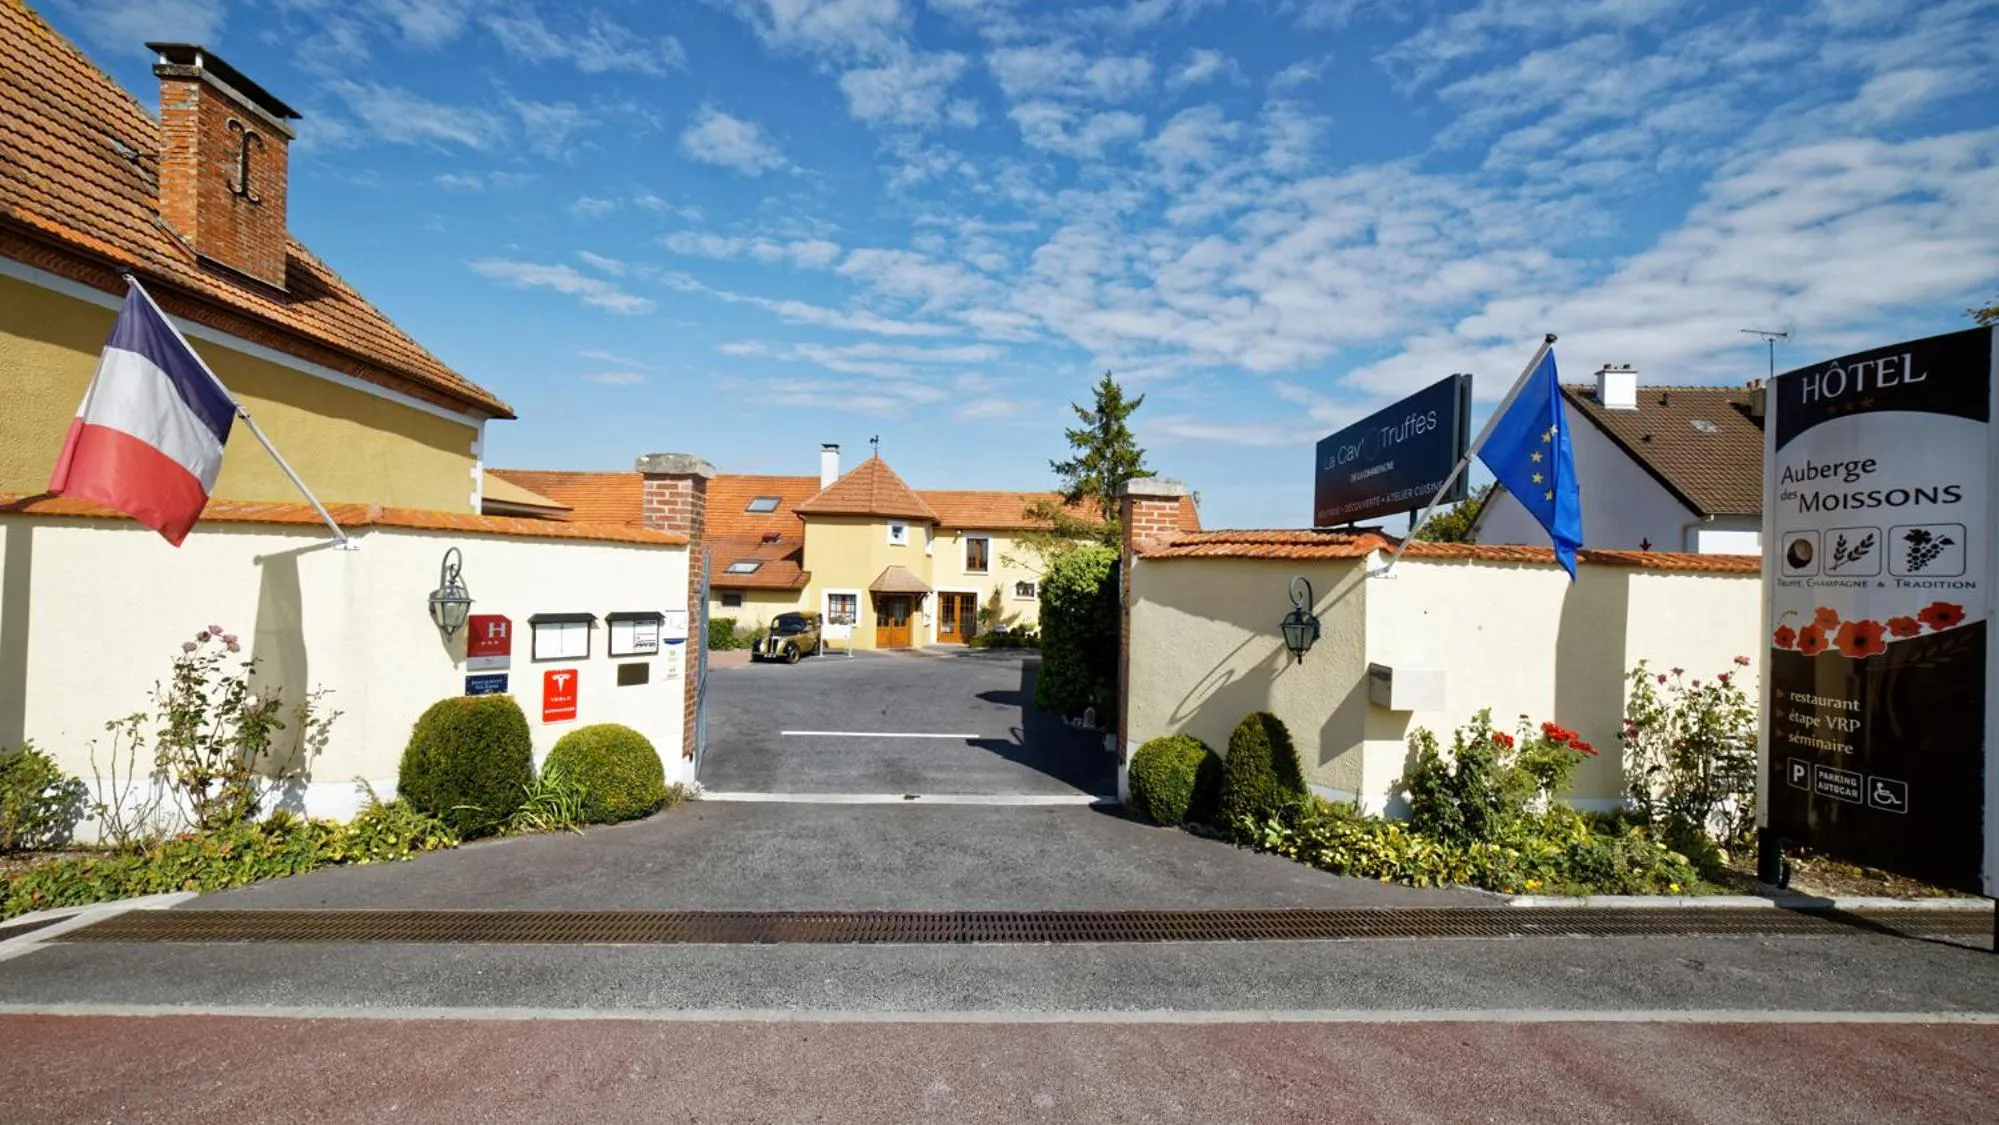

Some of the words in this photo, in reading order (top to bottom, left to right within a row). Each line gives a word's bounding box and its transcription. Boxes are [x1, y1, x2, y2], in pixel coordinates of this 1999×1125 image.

[1801, 353, 1928, 404] HÔTEL
[1380, 410, 1438, 448] Truffes
[1781, 458, 1877, 485] Auberge
[1780, 489, 1798, 501] des
[1799, 484, 1963, 513] MOISSONS
[1893, 578, 1976, 589] TRADITION
[488, 622, 506, 638] H
[1790, 691, 1861, 712] restaurant
[1788, 708, 1821, 729] étape
[1824, 715, 1861, 732] VRP
[1788, 729, 1854, 755] séminaire
[1793, 764, 1805, 782] P
[1819, 771, 1857, 786] PARKING
[1818, 781, 1859, 798] AUTOCAR
